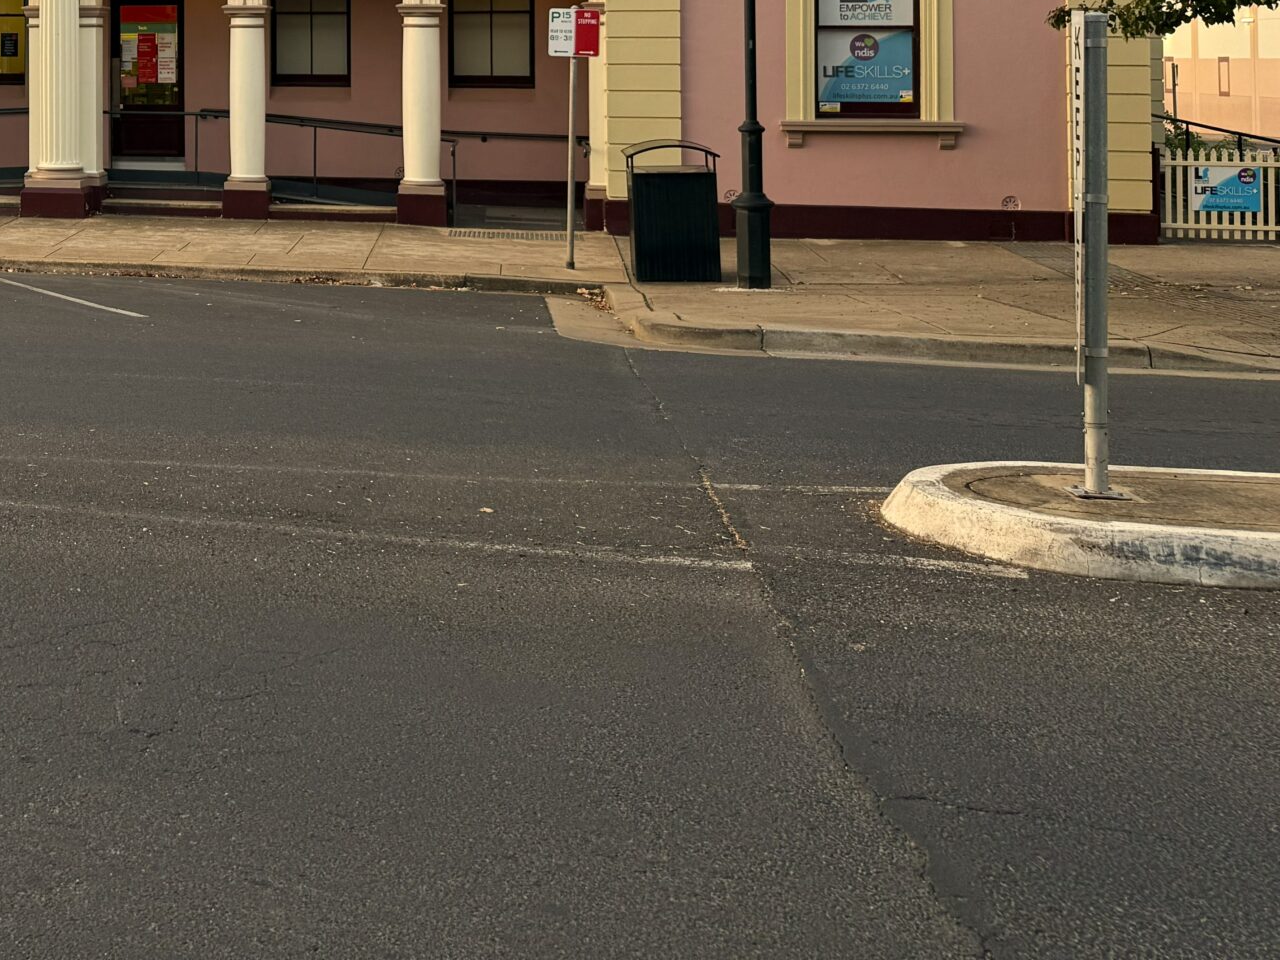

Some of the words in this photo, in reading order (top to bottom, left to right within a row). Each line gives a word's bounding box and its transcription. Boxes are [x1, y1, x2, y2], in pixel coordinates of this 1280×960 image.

[839, 3, 892, 12] EMPOWER
[840, 13, 849, 21] to
[850, 12, 893, 21] ACHIEVE
[854, 48, 875, 57] ndis
